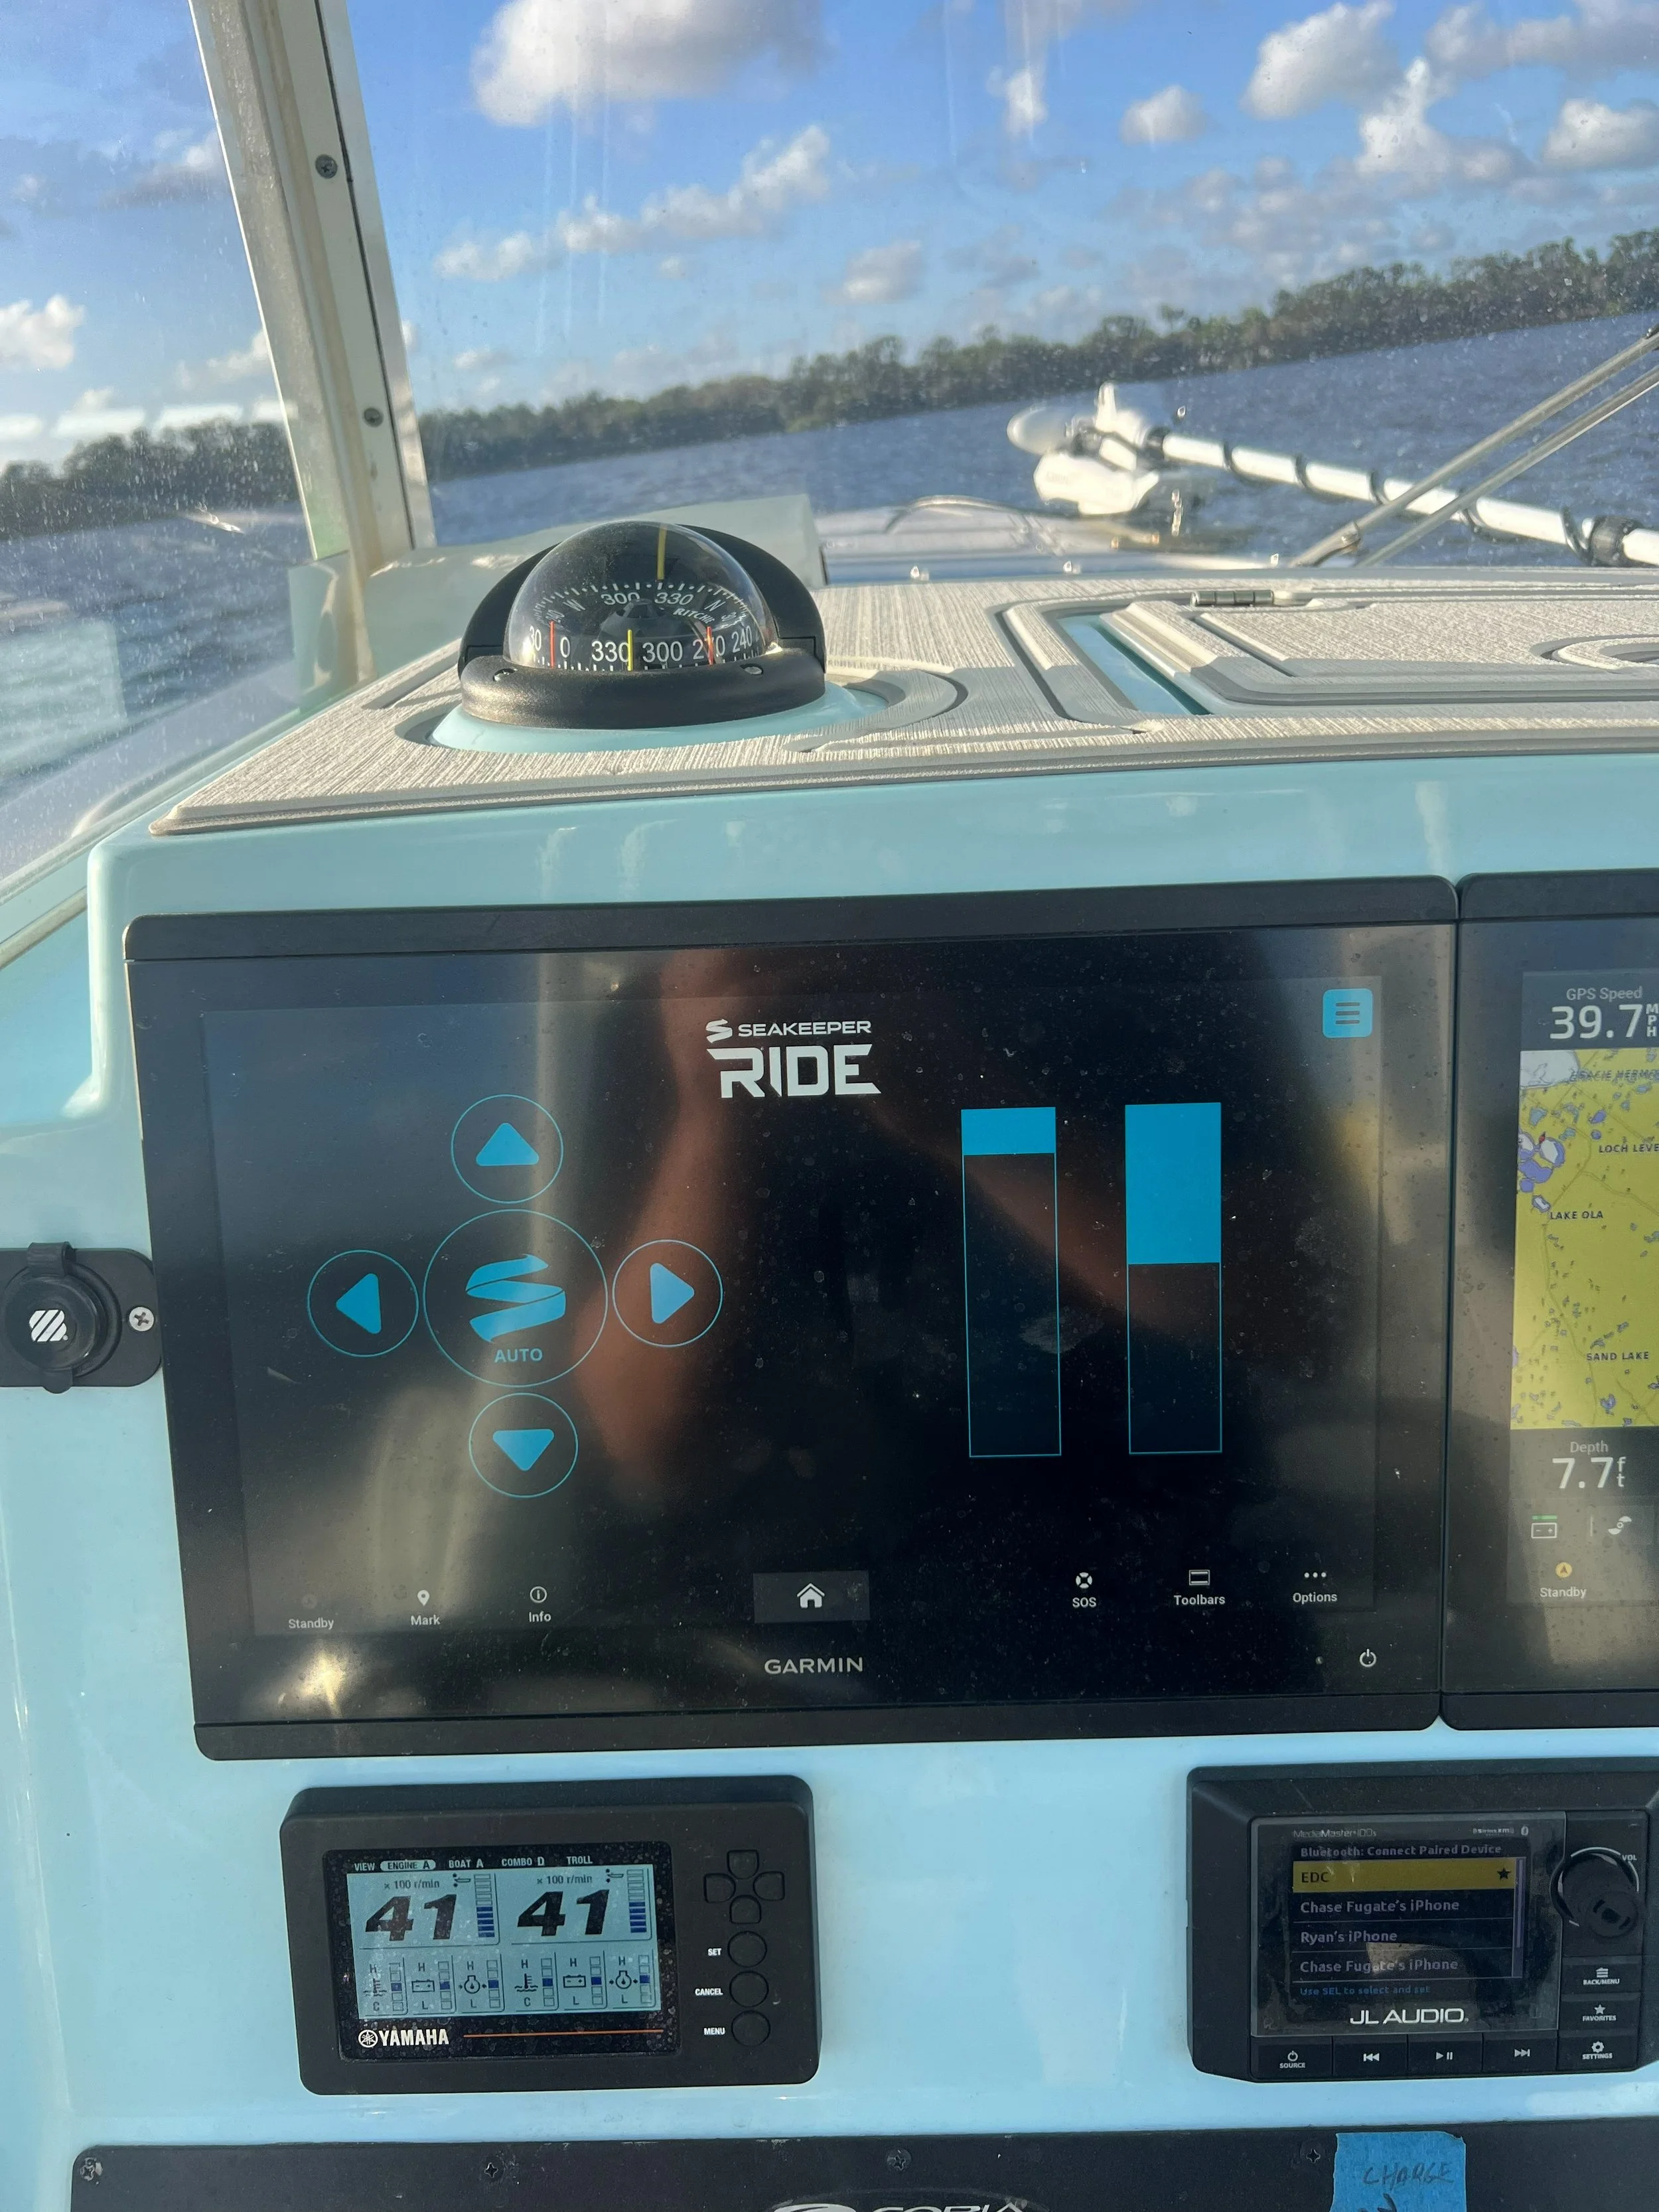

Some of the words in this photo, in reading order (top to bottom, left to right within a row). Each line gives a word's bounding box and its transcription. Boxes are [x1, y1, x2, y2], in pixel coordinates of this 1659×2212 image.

[563, 599, 585, 611] W
[601, 592, 640, 605] 300
[654, 592, 693, 605] 330
[704, 599, 725, 611] N
[673, 608, 715, 624] RITCHIE
[560, 637, 570, 658] 0
[592, 641, 630, 662] 330
[642, 641, 683, 662] 300
[731, 626, 752, 653] 240
[1566, 988, 1596, 1001] GPS
[1599, 986, 1643, 1002] Speed
[1550, 1003, 1643, 1039] 39.7
[738, 1020, 871, 1037] SEAKEEPER
[706, 1044, 881, 1098] RIDE
[1599, 1144, 1628, 1153] LOCH
[1550, 1211, 1577, 1220] LAKE
[1581, 1211, 1603, 1219] OLA
[494, 1348, 543, 1363] AUTO
[1622, 1351, 1649, 1360] LAKE
[1570, 1440, 1609, 1455] Depth
[1552, 1457, 1613, 1489] 7.7
[1292, 1592, 1338, 1605] Options
[1540, 1587, 1587, 1599] Standby
[1072, 1597, 1097, 1608] SOS
[1173, 1594, 1226, 1606] Toolbars
[411, 1615, 441, 1626] Mark
[529, 1611, 551, 1623] Info
[288, 1617, 334, 1630] Standby
[764, 1657, 863, 1674] GARMIN
[1300, 1846, 1363, 1858] Bluetooth:
[1367, 1846, 1416, 1856] Connect
[1419, 1845, 1458, 1855] Paired
[1461, 1844, 1501, 1854] Device
[354, 1862, 375, 1871] VIEW
[388, 1861, 417, 1870] ENGINE
[423, 1860, 430, 1870] A
[449, 1859, 471, 1868] BOAT
[476, 1858, 484, 1868] A
[502, 1858, 532, 1866] COMBO
[538, 1857, 545, 1866] D
[567, 1856, 593, 1865] TROLL
[547, 1876, 563, 1884] 100
[567, 1875, 593, 1883] r/min
[1301, 1872, 1330, 1883] EDC
[395, 1880, 411, 1889] 100
[414, 1880, 440, 1889] r/min
[518, 1889, 609, 1936] 41
[1300, 1901, 1342, 1913] Chase
[1346, 1899, 1406, 1914] Fugate's
[1410, 1899, 1460, 1911] iPhone
[365, 1894, 457, 1941] 41
[1301, 1931, 1344, 1945] Ryan's
[1348, 1930, 1398, 1942] iPhone
[418, 1962, 425, 1971] H
[467, 1961, 474, 1970] H
[521, 1959, 528, 1968] H
[570, 1958, 577, 1966] H
[618, 1956, 626, 1965] H
[1300, 1961, 1342, 1973] Chase
[1346, 1960, 1405, 1974] Fugate's
[1409, 1958, 1458, 1970] iPhone
[370, 1964, 377, 1973] H
[422, 2000, 428, 2010] L
[470, 1999, 476, 2008] L
[524, 1997, 531, 2007] C
[573, 1996, 579, 2005] L
[622, 1995, 628, 2004] L
[373, 2002, 380, 2011] C
[1350, 2010, 1379, 2024] JL
[1382, 2008, 1465, 2024] AUDIO
[378, 2029, 449, 2046] YAMAHA
